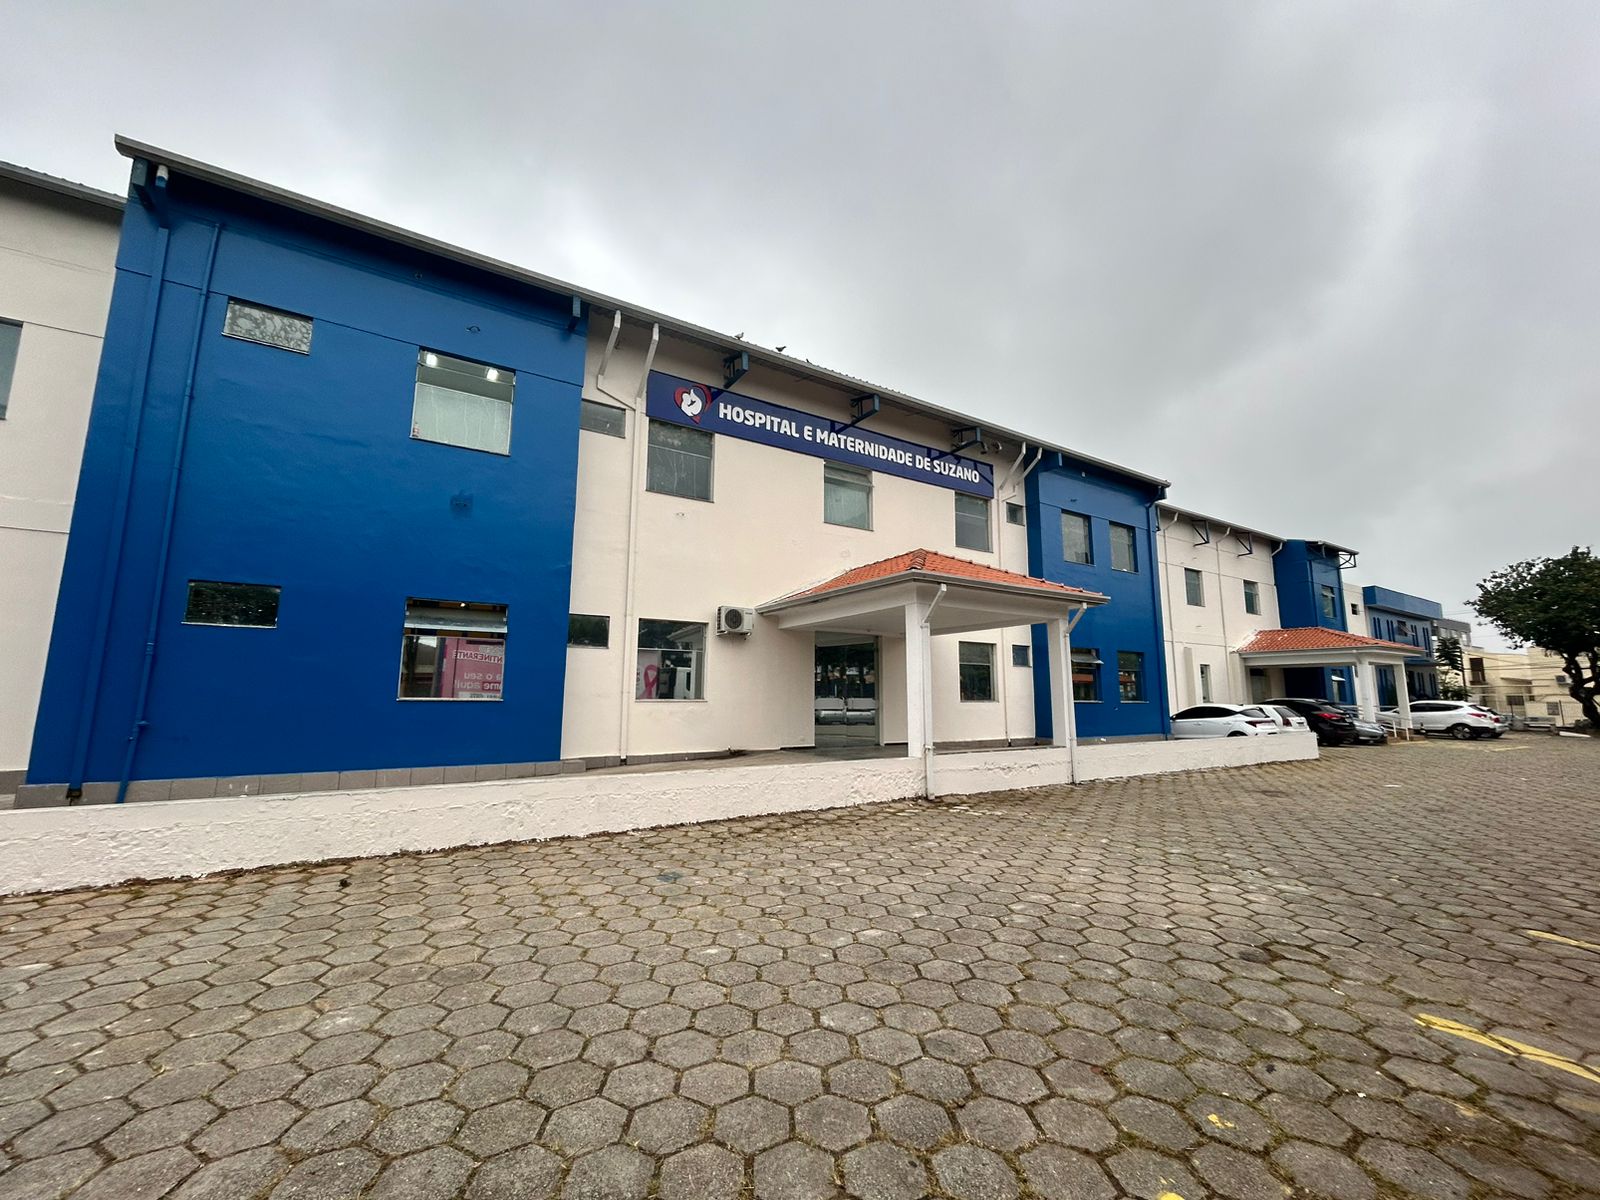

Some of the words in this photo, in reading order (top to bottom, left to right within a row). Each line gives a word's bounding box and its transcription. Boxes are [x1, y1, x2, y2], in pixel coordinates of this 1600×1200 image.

[718, 402, 800, 438] HOSPITAL
[803, 425, 813, 441] E
[816, 428, 913, 466] MATERNIDADE
[915, 455, 931, 471] DE
[933, 459, 980, 483] SUZANO
